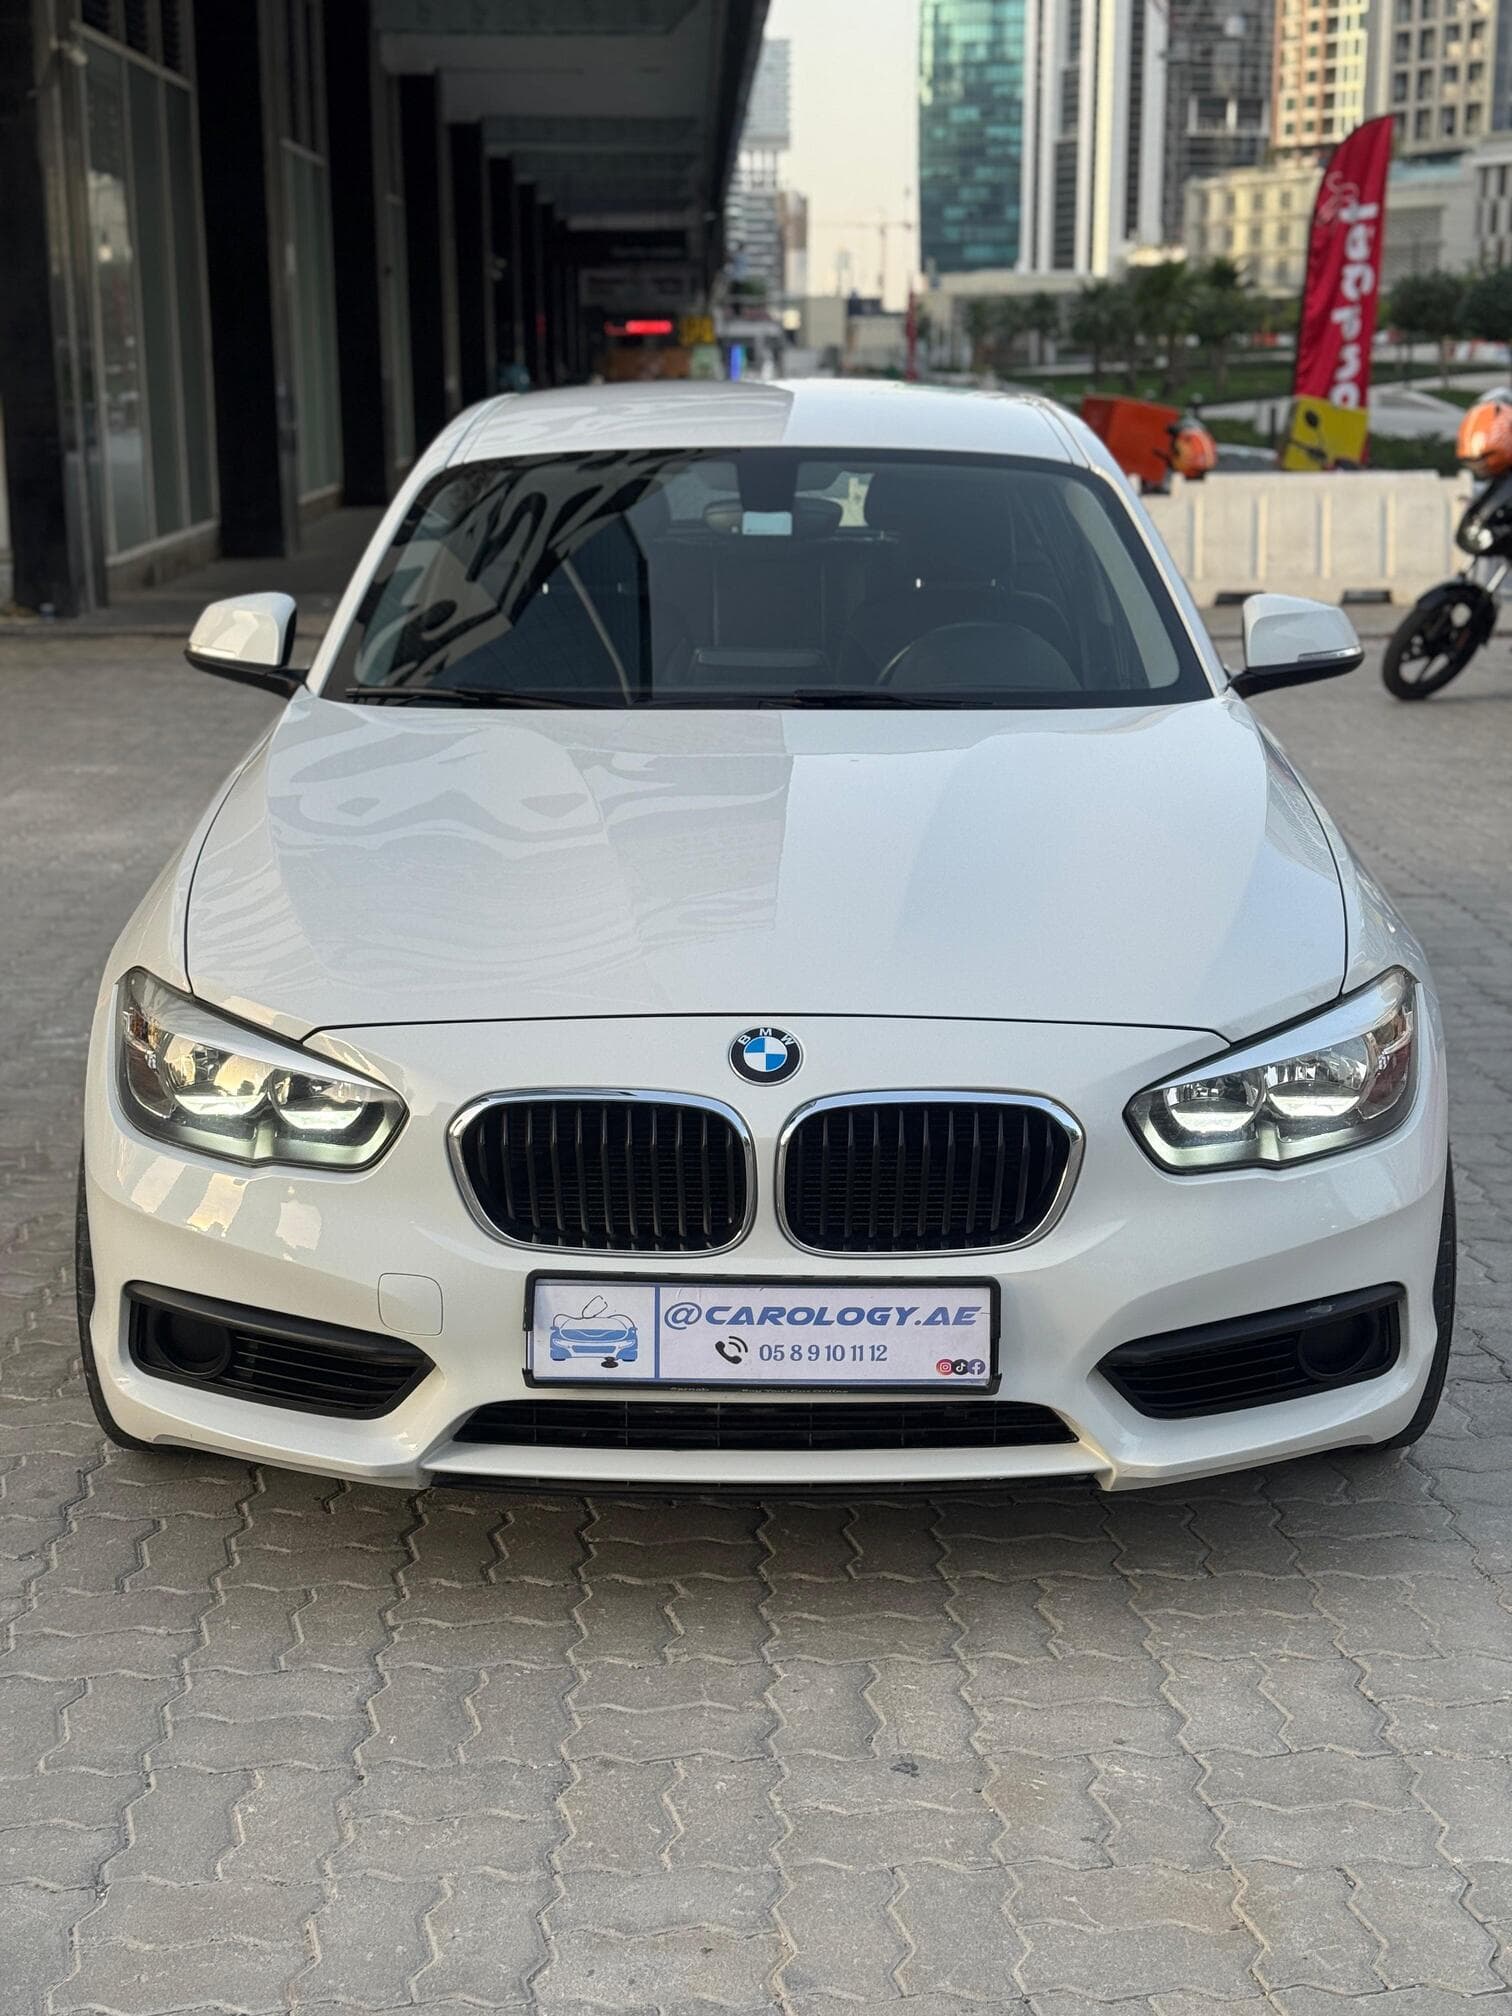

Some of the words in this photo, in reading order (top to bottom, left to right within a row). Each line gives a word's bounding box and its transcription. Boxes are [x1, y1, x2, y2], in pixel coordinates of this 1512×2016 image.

[737, 1028, 796, 1046] BMW
[664, 1301, 982, 1330] @CAROLOGY.AE
[759, 1344, 785, 1362] 05
[790, 1344, 803, 1362] 8
[807, 1344, 820, 1362] 9
[825, 1344, 845, 1362] 10
[851, 1344, 864, 1362] 11
[868, 1344, 888, 1362] 12
